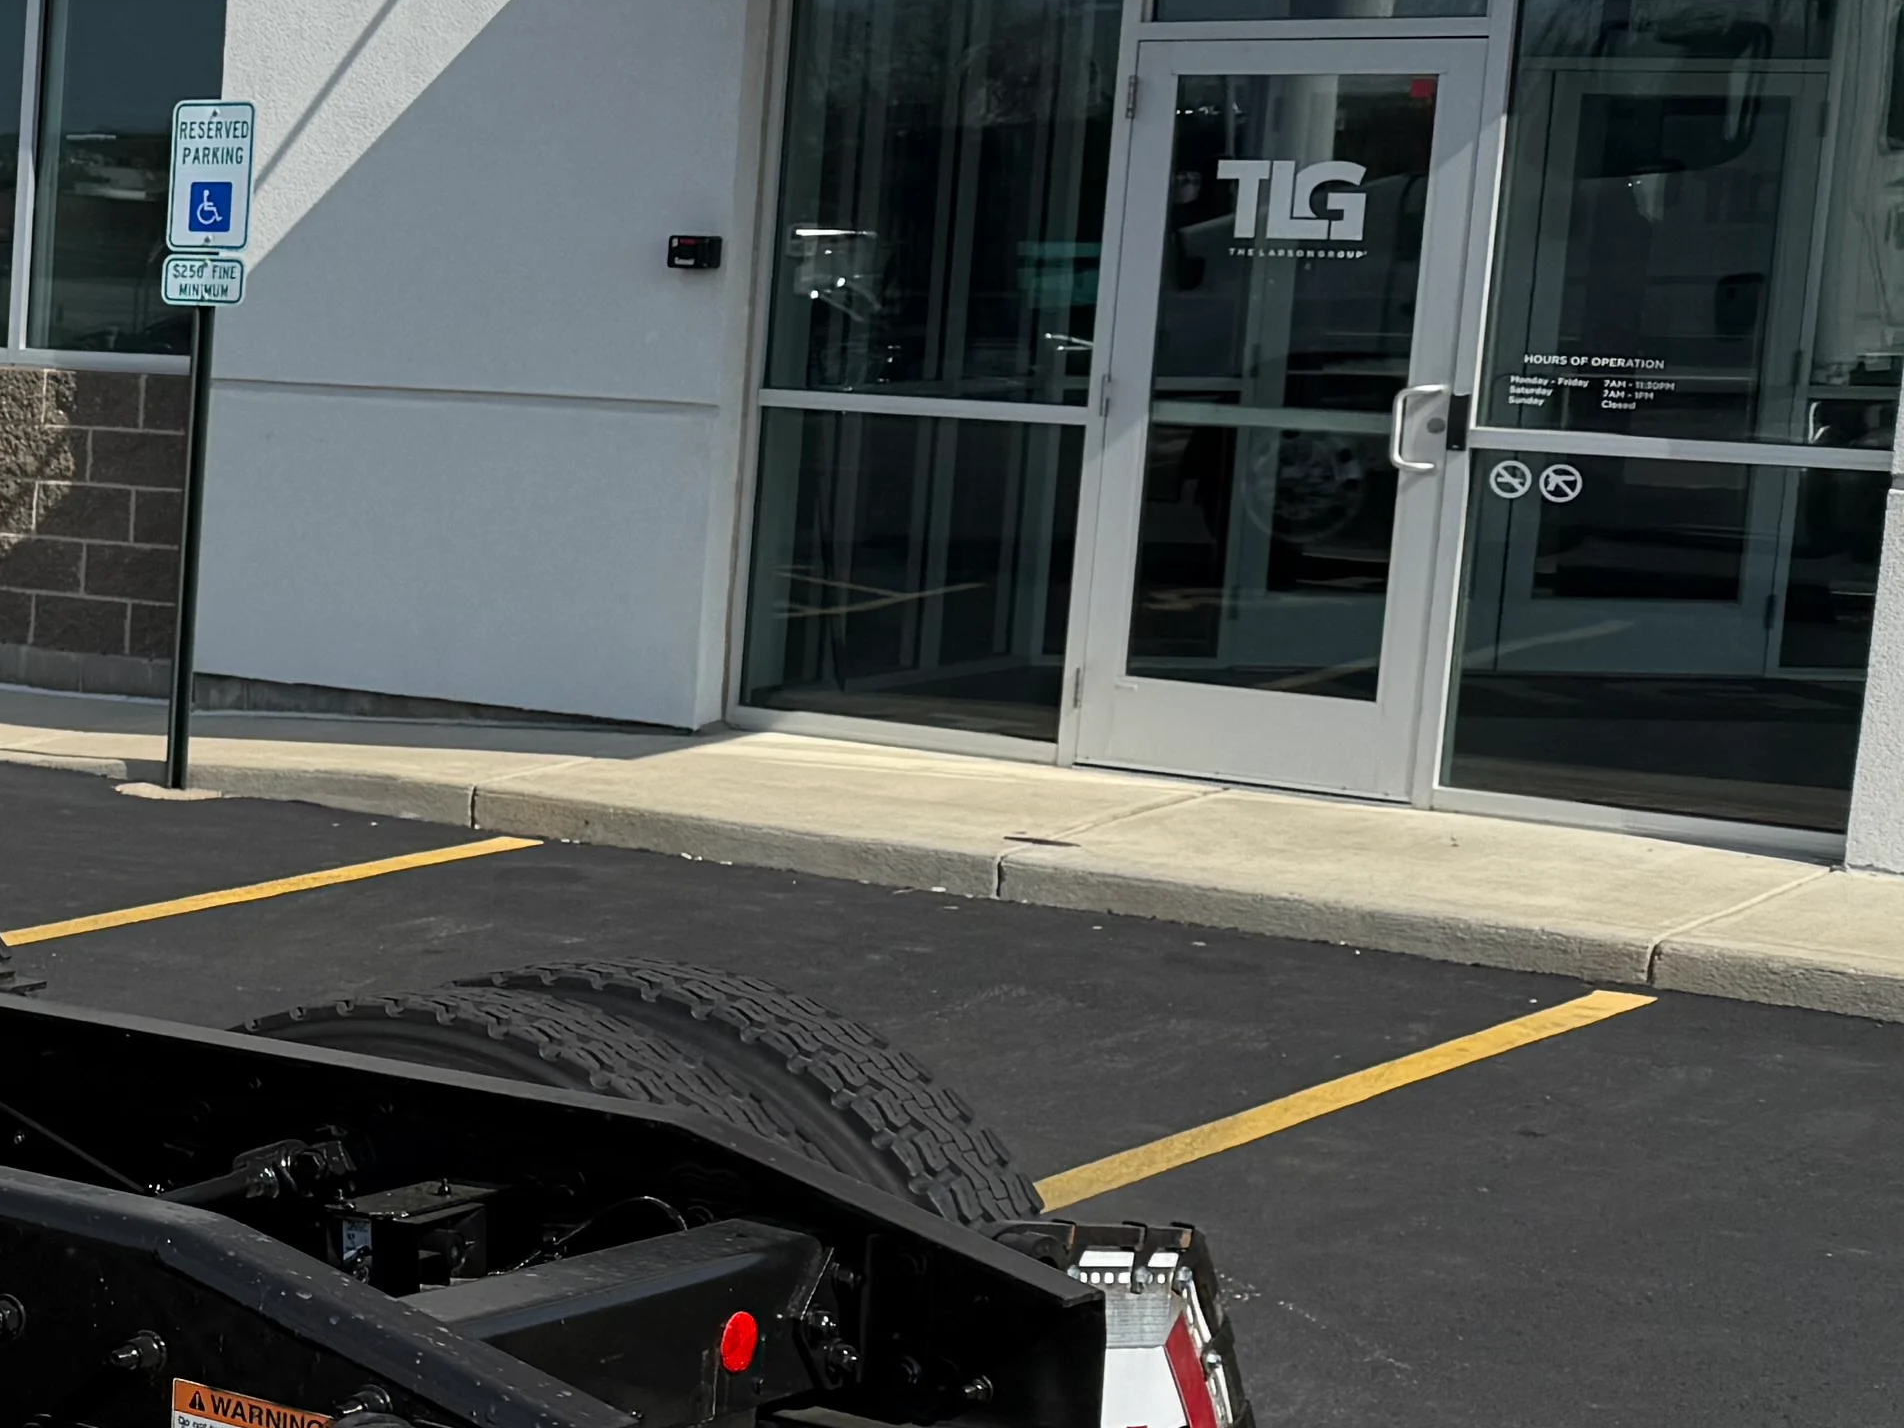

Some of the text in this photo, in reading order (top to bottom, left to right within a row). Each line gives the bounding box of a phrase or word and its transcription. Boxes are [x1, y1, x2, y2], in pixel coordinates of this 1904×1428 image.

[179, 120, 249, 140] RESERVED
[182, 146, 244, 165] PARKING
[1216, 159, 1367, 241] TLG
[1228, 248, 1254, 257] THE
[1258, 249, 1315, 258] LARSON
[172, 263, 237, 280] $250 FINE
[178, 283, 229, 298] MINIMUM
[1523, 354, 1665, 370] HOURS OF OPERATION
[1510, 375, 1549, 386] Monday
[1557, 377, 1590, 388] Friday
[1603, 379, 1626, 389] 7AM
[1509, 385, 1553, 397] Saturday
[1508, 396, 1636, 410] Sunday Closed
